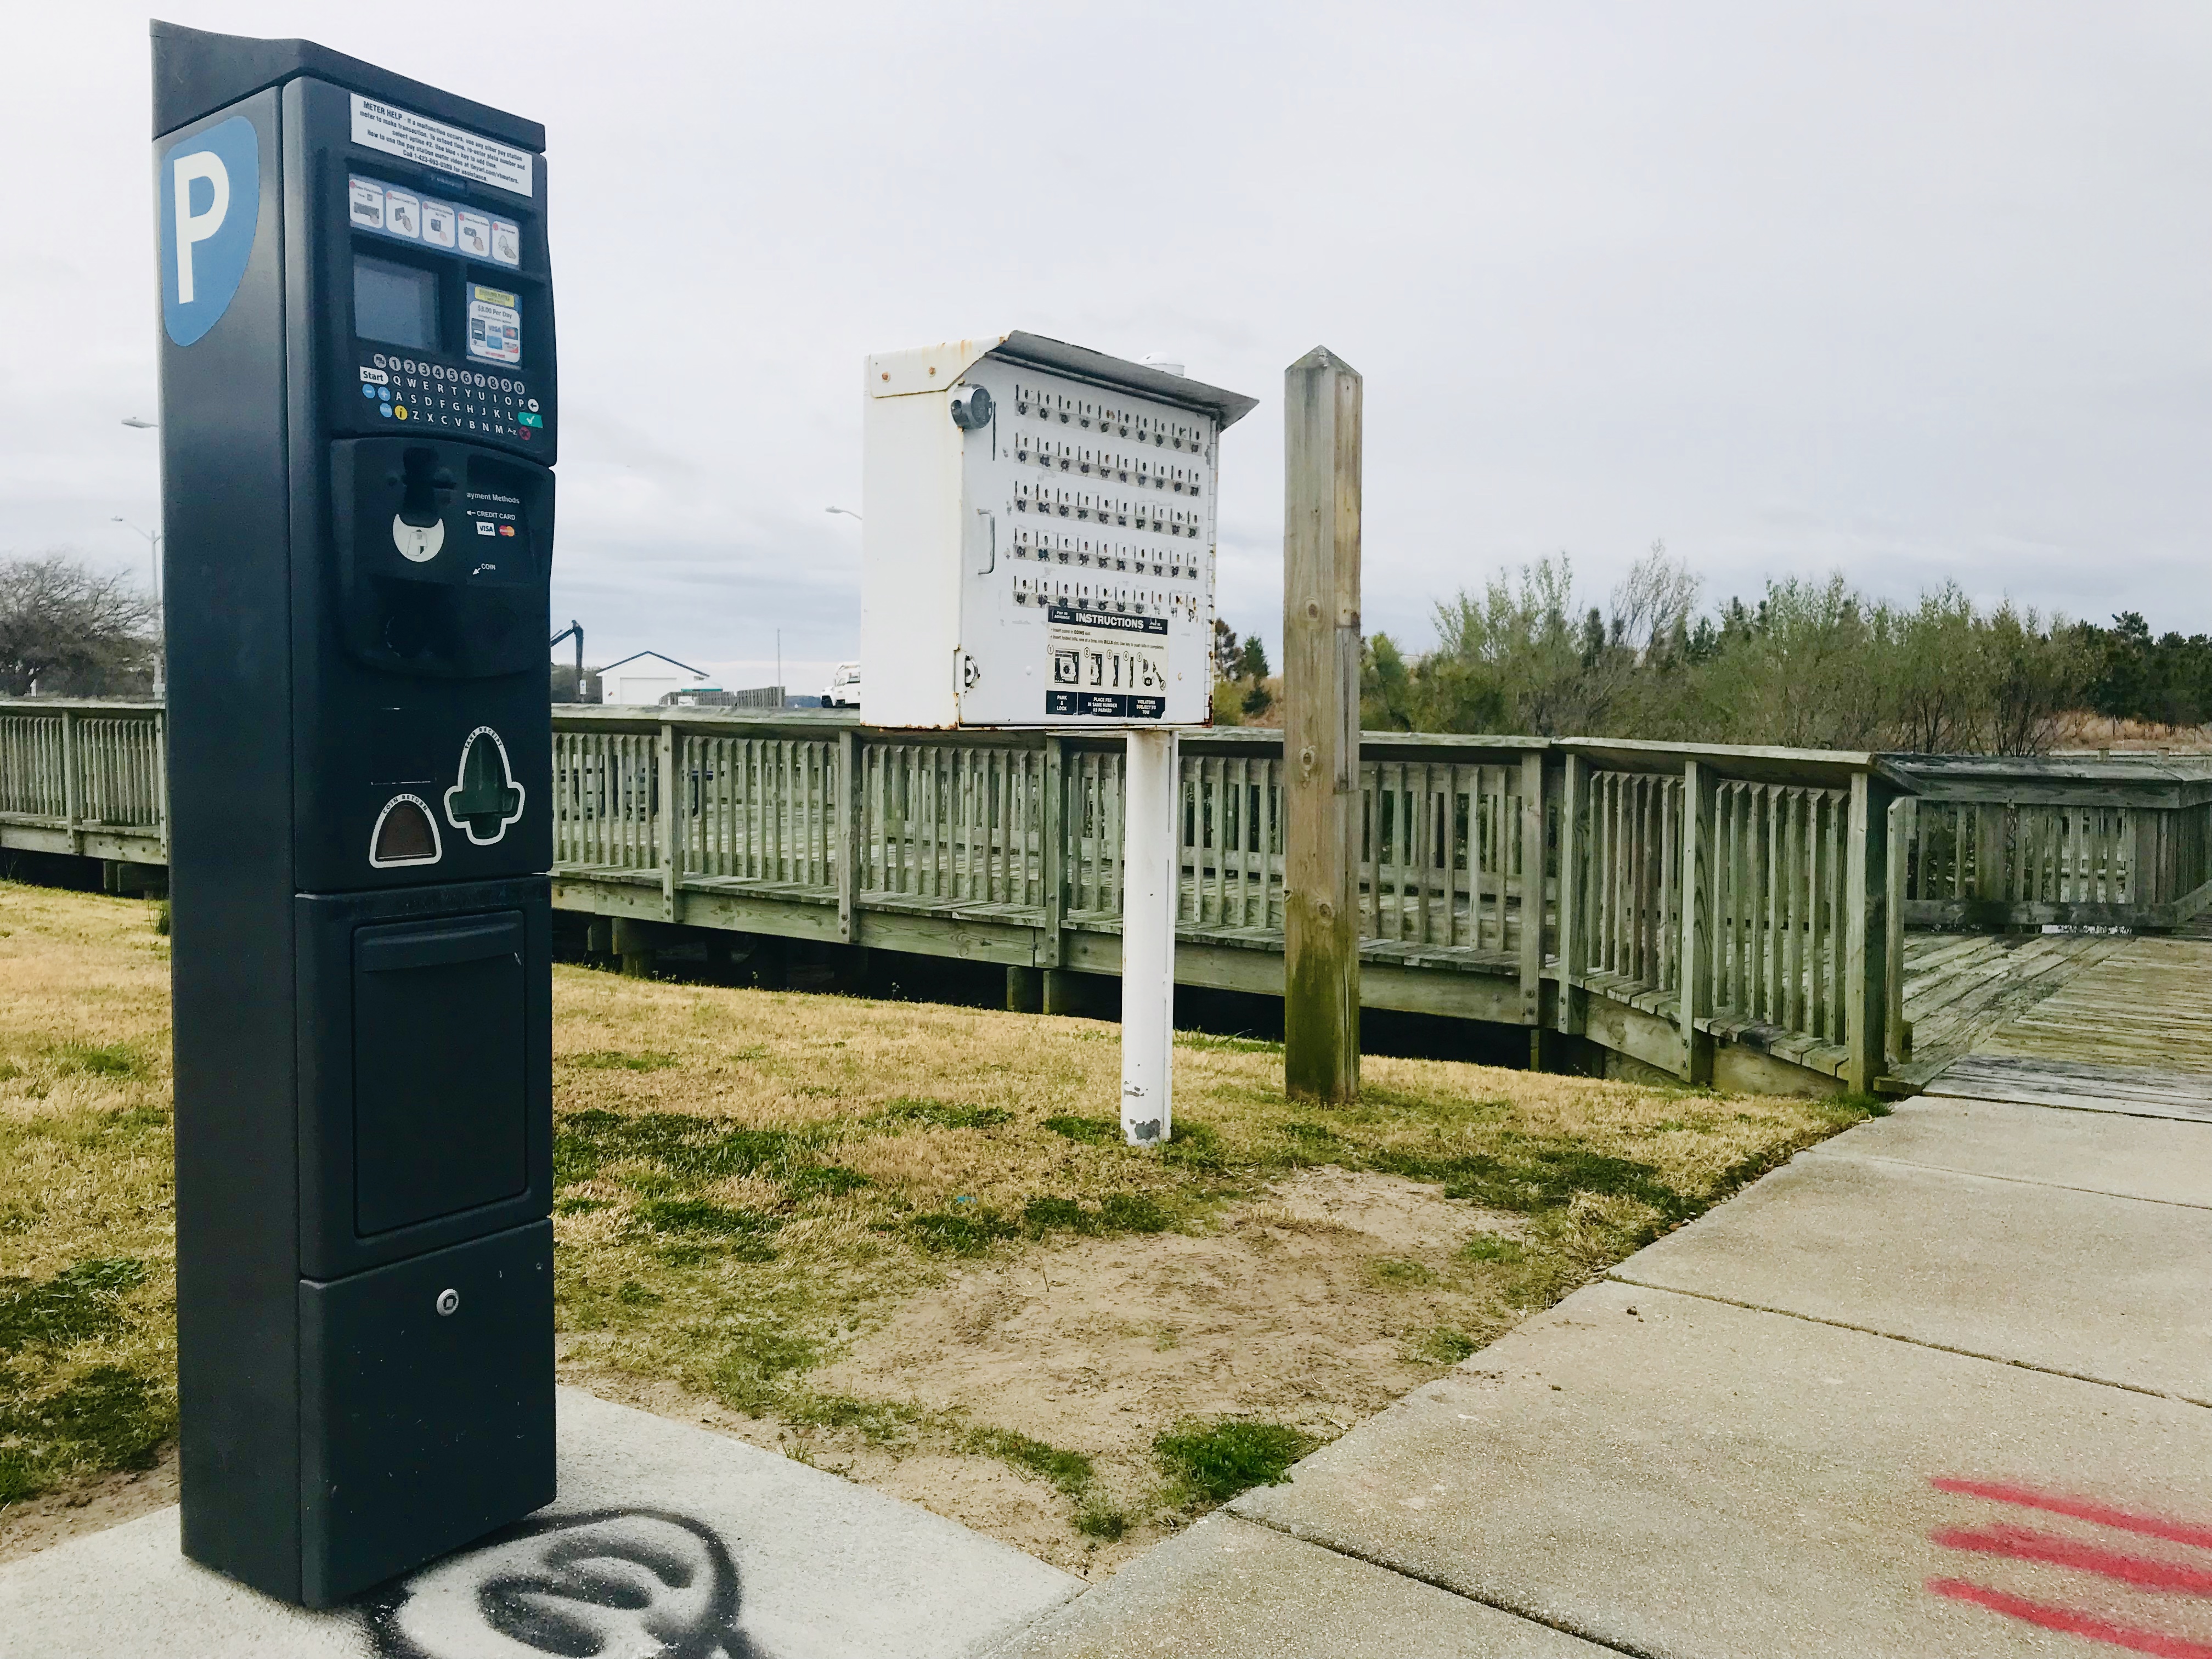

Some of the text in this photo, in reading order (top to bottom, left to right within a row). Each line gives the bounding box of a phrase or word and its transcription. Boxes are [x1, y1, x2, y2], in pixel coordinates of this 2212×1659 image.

[360, 111, 375, 120] meter
[383, 119, 397, 127] make
[363, 101, 385, 115] METER
[387, 109, 403, 121] HELP
[417, 122, 445, 136] malfunction
[507, 153, 522, 161] station
[368, 129, 378, 138] How
[416, 146, 433, 156] station
[173, 151, 229, 304] P
[363, 371, 524, 407] Start Q W E R T Y U I O P
[407, 362, 413, 372] 2
[421, 365, 427, 375] 3
[435, 368, 441, 377] 4
[450, 370, 455, 380] 5
[463, 374, 470, 382] 6
[477, 376, 482, 385] 7
[490, 379, 496, 388] 8
[504, 381, 509, 390] 9
[517, 383, 522, 393] 0
[396, 392, 514, 421] A S D F G H J K L
[413, 410, 420, 420] Z
[427, 413, 434, 422] X
[441, 415, 448, 425] C
[455, 417, 461, 427] V
[469, 420, 476, 429] B
[482, 422, 489, 432] N
[495, 425, 504, 434] M
[492, 494, 520, 504] Methods
[1076, 612, 1144, 629] INSTRUCTIONS
[479, 727, 502, 746] RECEIPT
[383, 795, 427, 814] COIN RETURN
